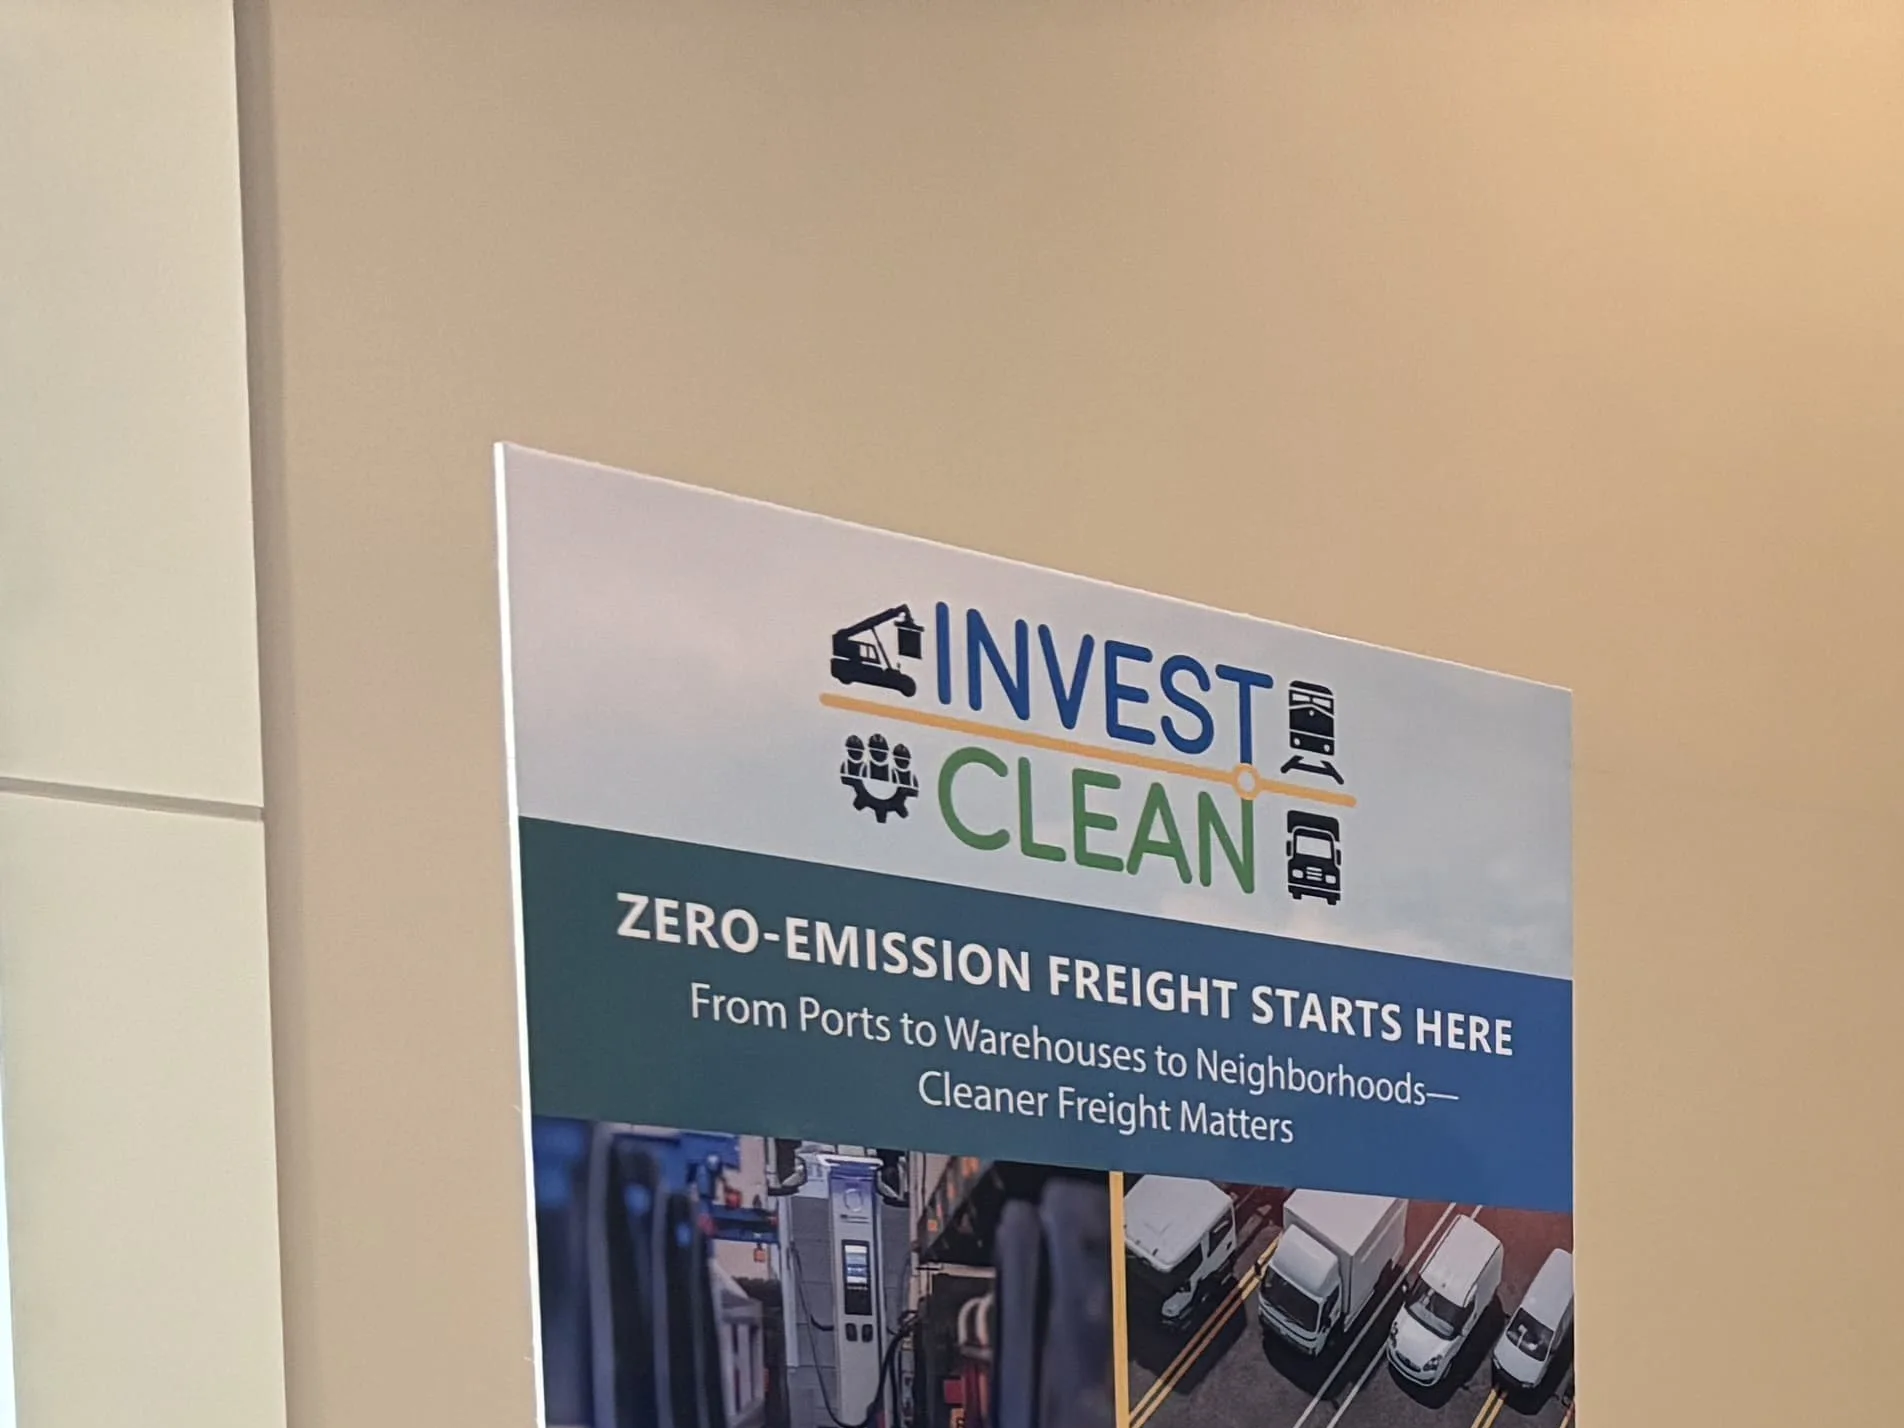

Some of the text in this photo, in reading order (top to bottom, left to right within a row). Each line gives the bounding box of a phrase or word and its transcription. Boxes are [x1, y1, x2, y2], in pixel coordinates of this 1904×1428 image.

[933, 599, 1274, 767] INVEST
[936, 745, 1256, 895] CLEAN
[616, 891, 1513, 1056] ZERO-EMISSION FREIGHT STARTS HERE
[690, 981, 787, 1030] From
[799, 995, 891, 1042] Ports
[898, 1012, 937, 1048] to
[943, 1014, 1147, 1073] Warehouses
[1153, 1044, 1187, 1078] to
[918, 1070, 1294, 1144] Cleaner Freight Matters
